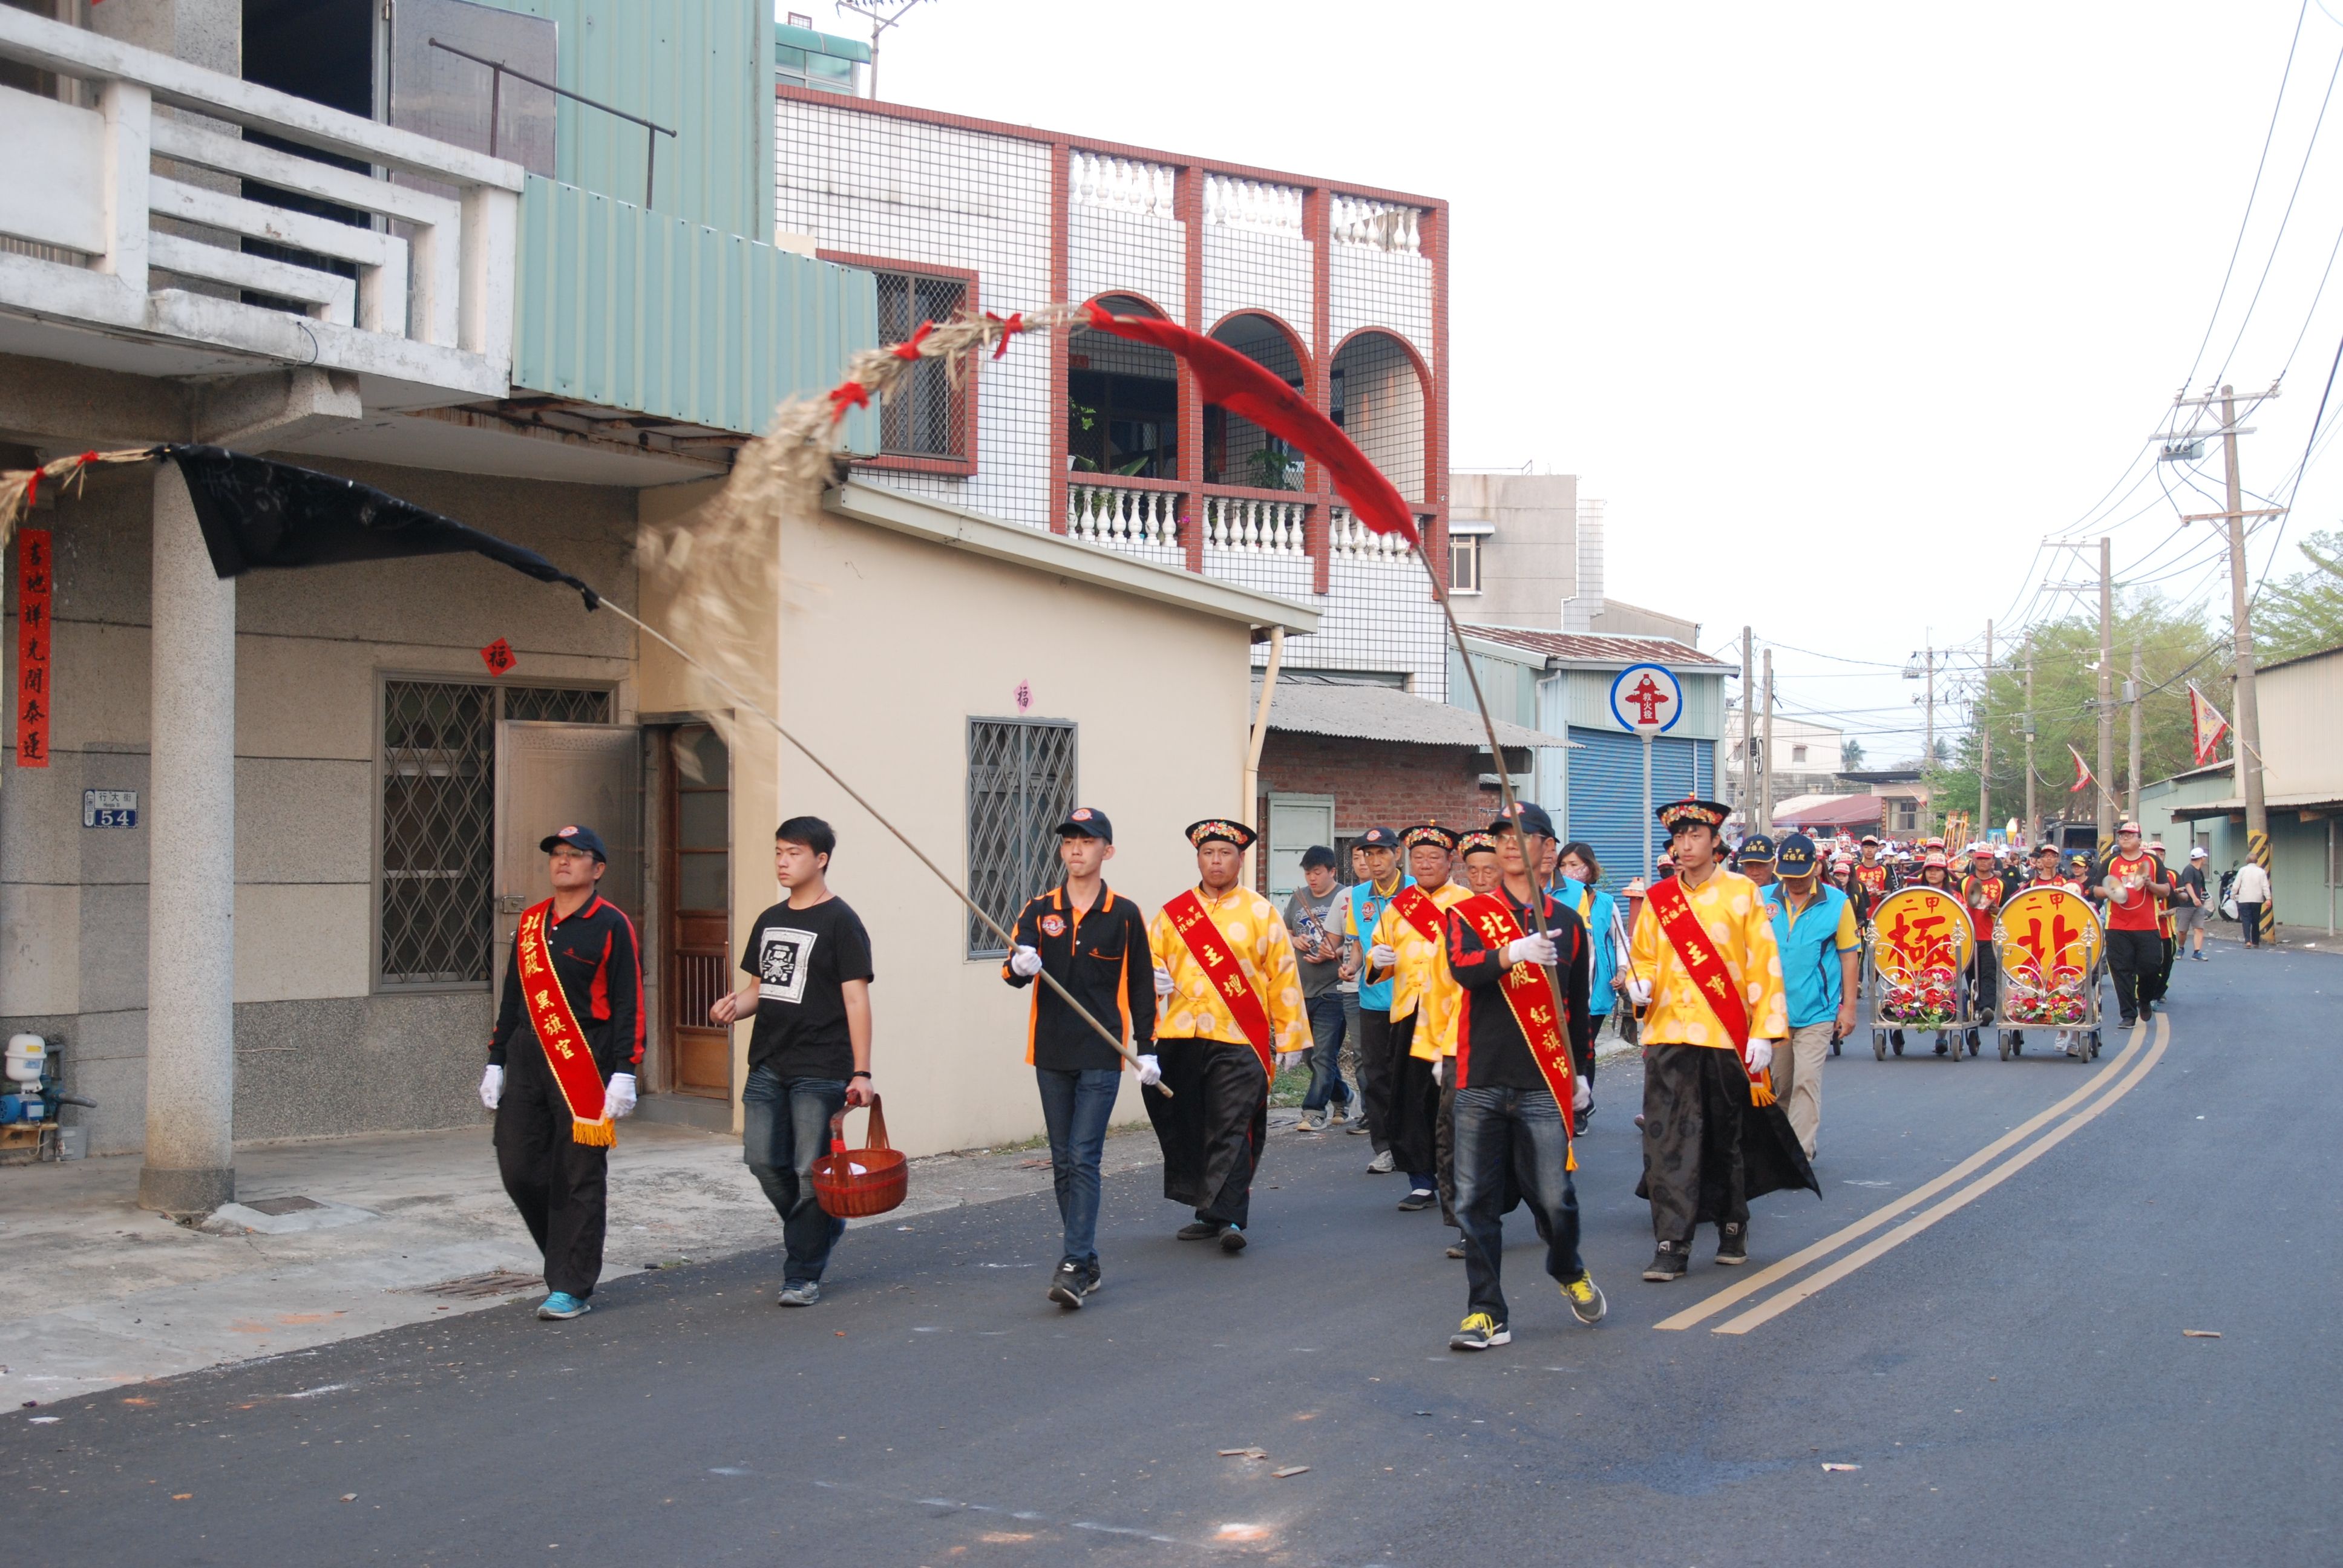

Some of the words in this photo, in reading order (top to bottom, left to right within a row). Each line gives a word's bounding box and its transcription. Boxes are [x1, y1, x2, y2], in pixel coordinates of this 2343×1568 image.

[23, 540, 46, 759] 吉地祥光開泰運
[488, 645, 508, 668] 福
[1017, 687, 1029, 708] 福
[99, 792, 131, 802] 行大街
[102, 810, 129, 826] 54
[1903, 897, 1939, 913] 二甲
[2026, 893, 2064, 910] 二甲
[1177, 906, 1194, 923] 二甲
[1179, 911, 1204, 933] 北極殿
[1662, 903, 1688, 926] 北極殿
[1887, 913, 1956, 979] 極
[2017, 915, 2083, 975] 北
[1203, 944, 1247, 997] 主壇
[1686, 941, 1726, 999] 主事
[520, 912, 544, 978] 北極殿
[535, 990, 574, 1060] 黑旗官
[1530, 1005, 1569, 1079] 紅旗官
